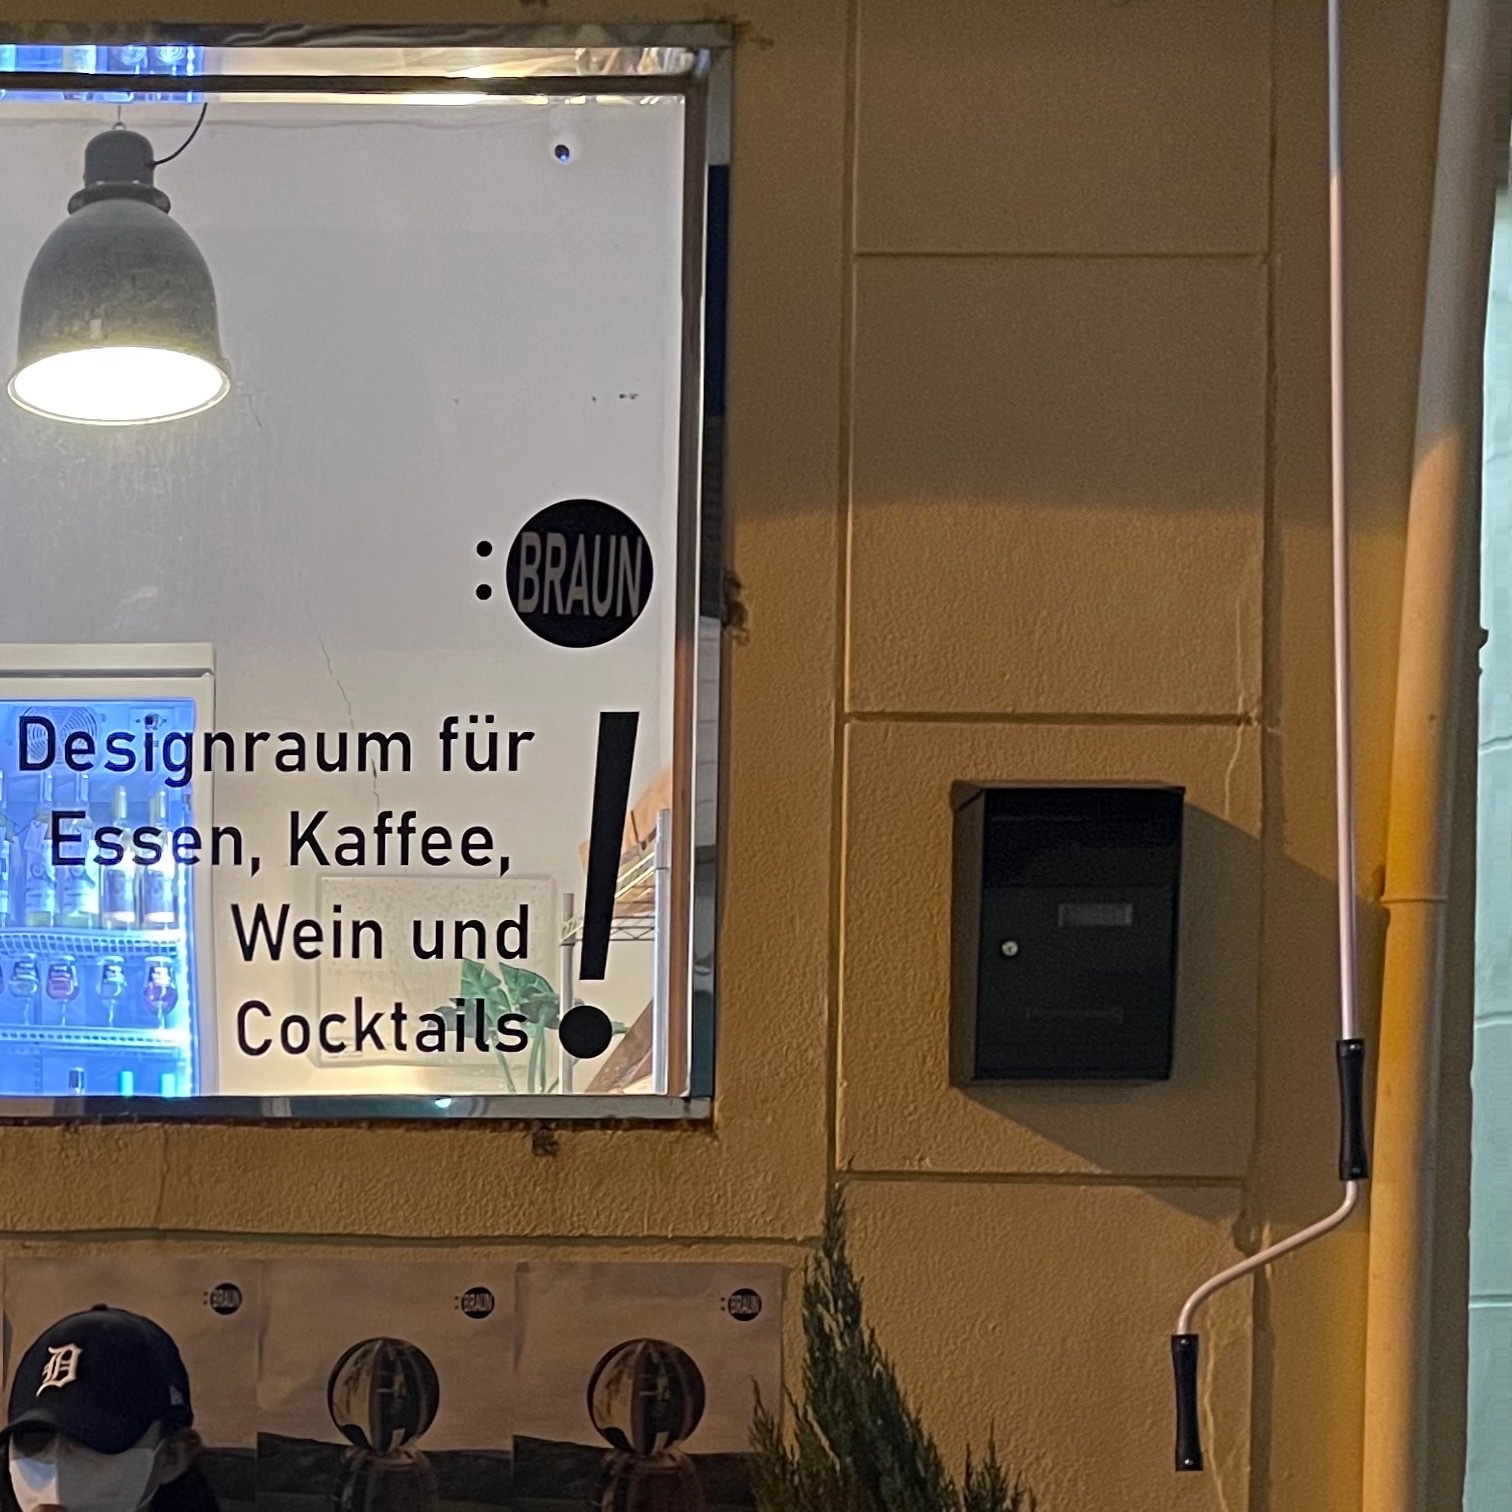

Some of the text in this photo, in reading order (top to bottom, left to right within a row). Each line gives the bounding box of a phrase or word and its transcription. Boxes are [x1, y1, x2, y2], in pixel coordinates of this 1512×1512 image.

[517, 531, 644, 618] BRAUN
[19, 714, 535, 788] Designraum für
[51, 810, 510, 877] Essen, Kaffee,
[231, 903, 529, 961] Wein und
[237, 996, 528, 1056] Cocktails
[35, 1342, 83, 1397] D
